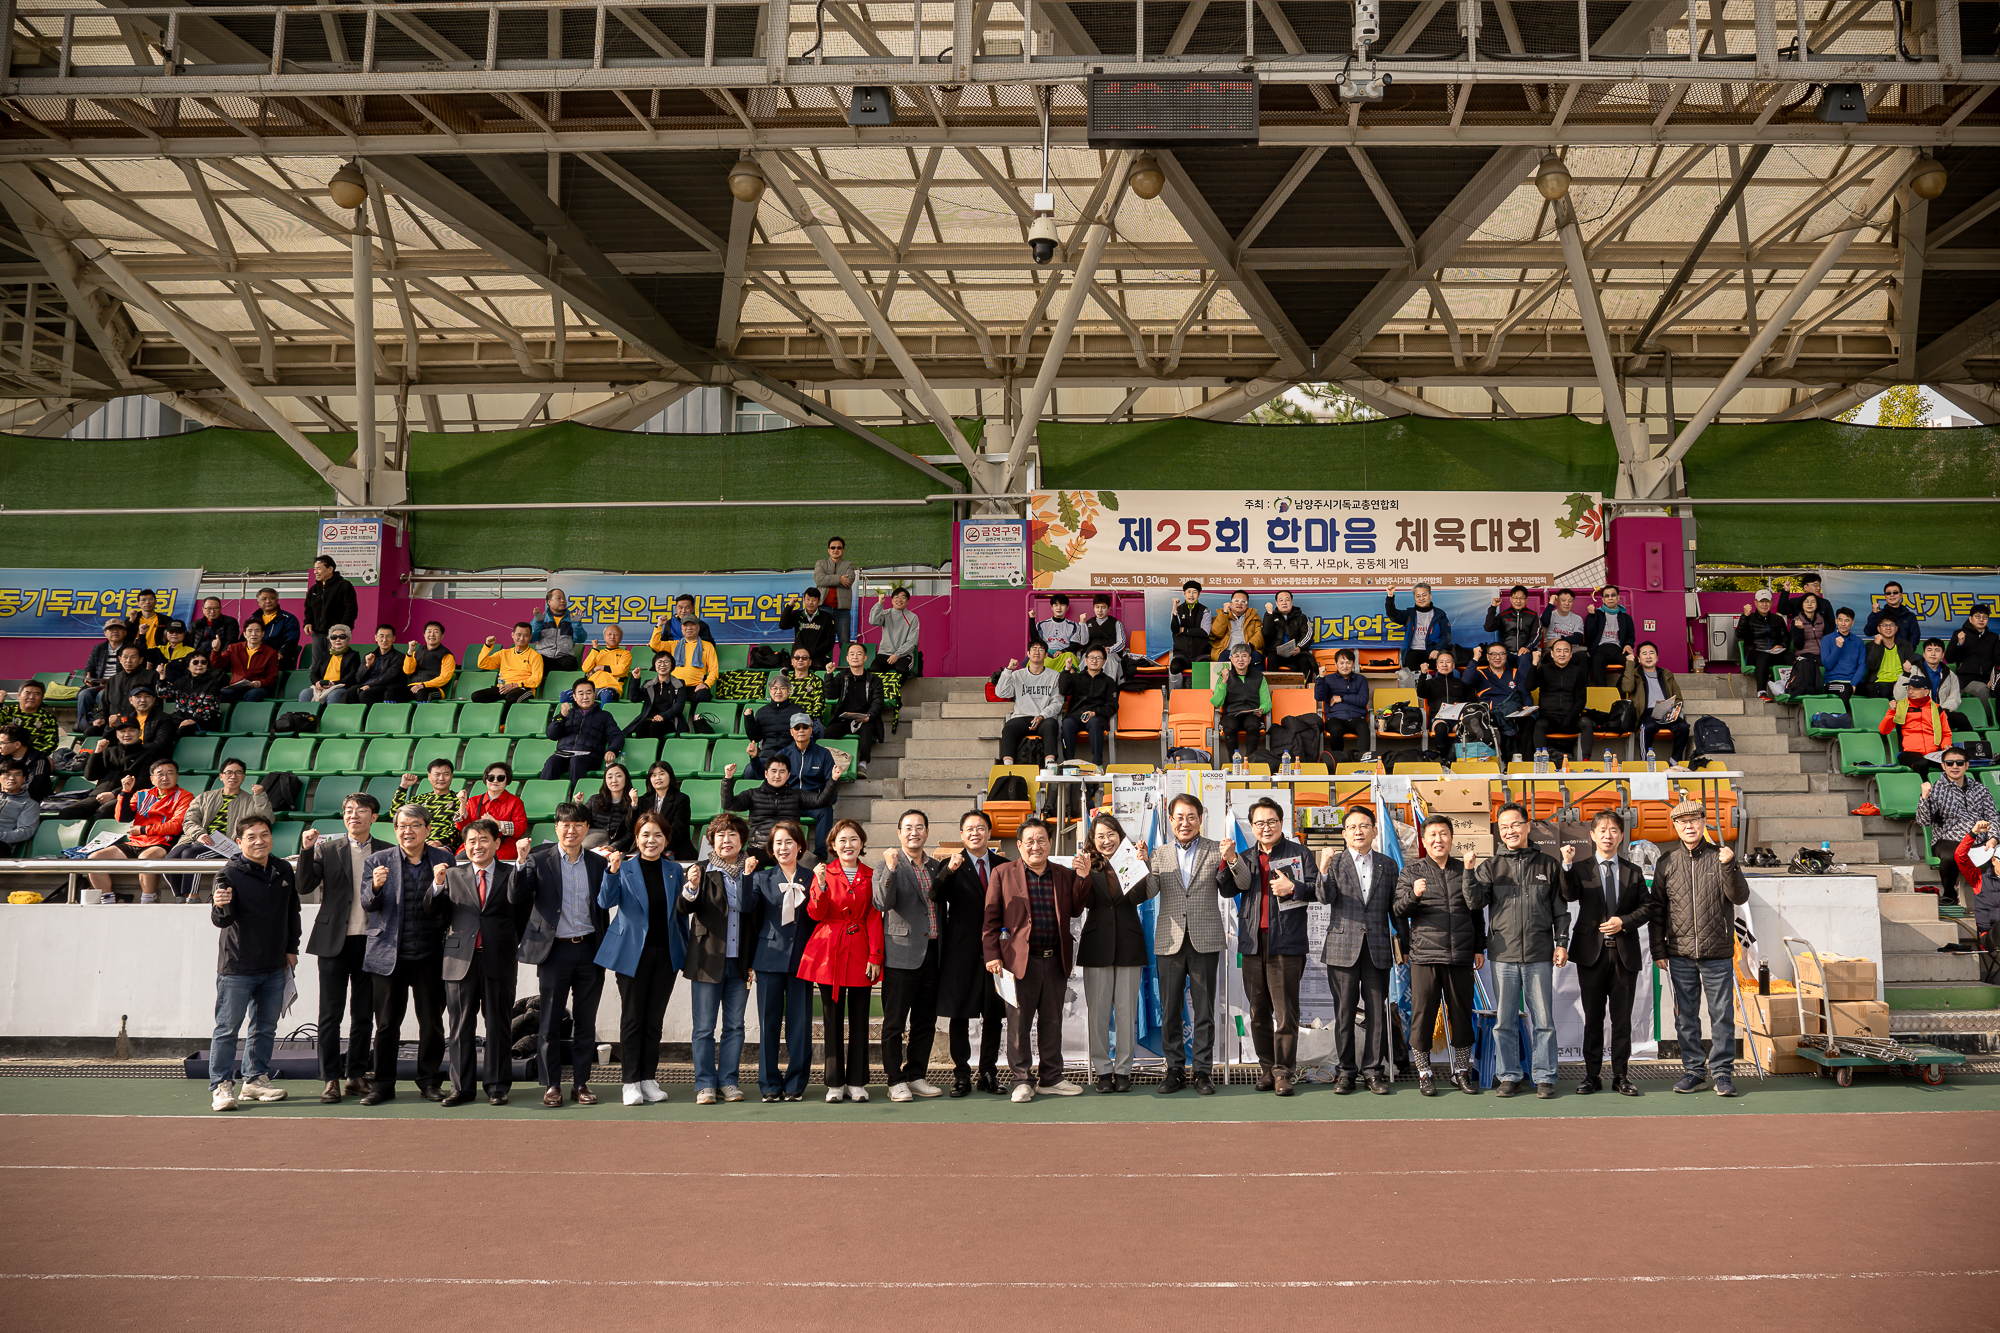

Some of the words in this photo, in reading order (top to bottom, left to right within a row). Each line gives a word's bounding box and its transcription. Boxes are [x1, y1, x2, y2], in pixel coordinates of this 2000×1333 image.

[1244, 499, 1264, 510] 주최
[1294, 499, 1399, 511] 남양주시기독교총연합회
[339, 525, 377, 535] 금연구역
[981, 526, 1020, 537] 금연구역
[1118, 516, 1249, 554] 제25회
[1266, 516, 1377, 554] 한마음
[1395, 516, 1541, 554] 체육대회
[1236, 558, 1260, 570] 축구,
[1262, 558, 1286, 570] 족구,
[1289, 558, 1313, 570] 탁구,
[1316, 558, 1353, 571] 사모pk,
[1356, 558, 1386, 570] 공동체
[1389, 558, 1409, 570] 게임
[1093, 576, 1107, 585] 일시
[1208, 577, 1222, 585] 오전
[1223, 577, 1242, 585] 10:00
[1252, 577, 1266, 585] 장소
[1348, 577, 1361, 585] 주최
[1454, 576, 1479, 585] 경기주관
[1021, 684, 1052, 697] ATHLETIC
